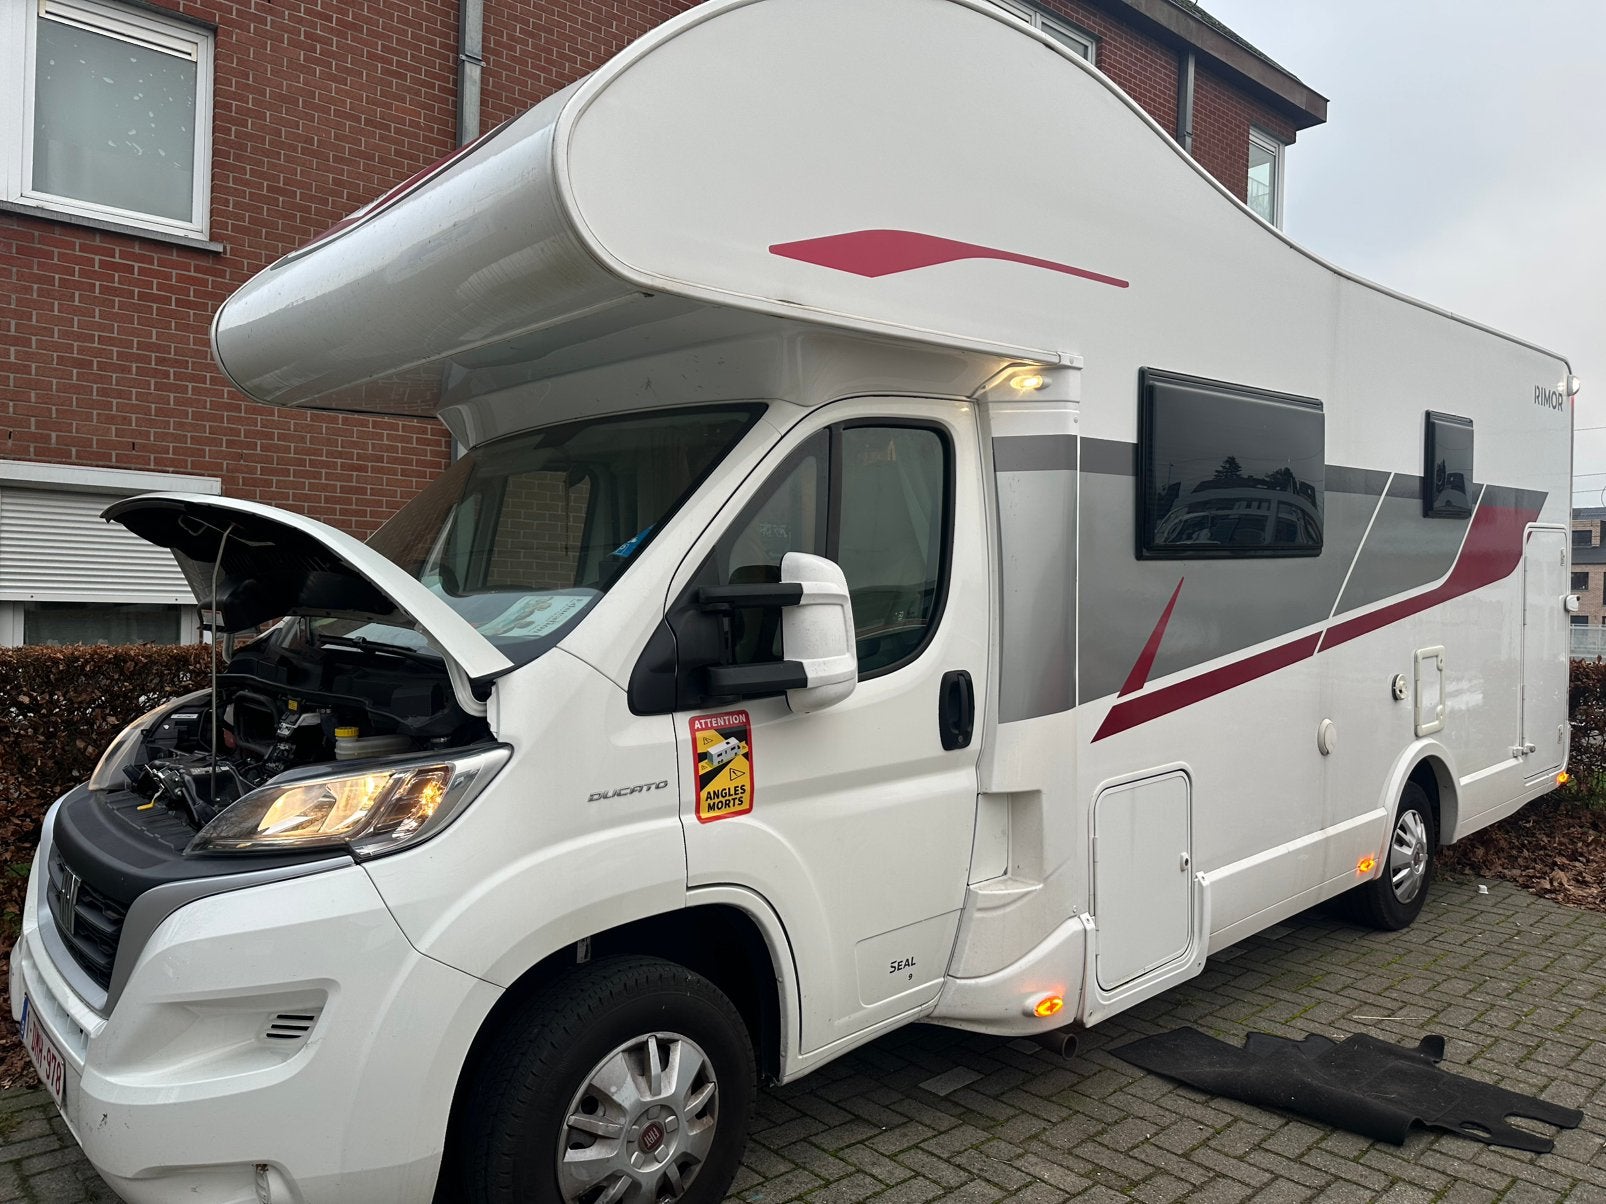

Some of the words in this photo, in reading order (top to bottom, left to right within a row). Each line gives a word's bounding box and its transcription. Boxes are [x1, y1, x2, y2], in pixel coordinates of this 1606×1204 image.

[1534, 384, 1564, 412] RIMOR
[694, 713, 747, 730] ATTENTION
[587, 780, 669, 802] DUCATO
[705, 784, 747, 802] ANGLES
[707, 796, 744, 813] MORTS
[889, 956, 917, 974] SEAL
[642, 1124, 662, 1148] FIAT
